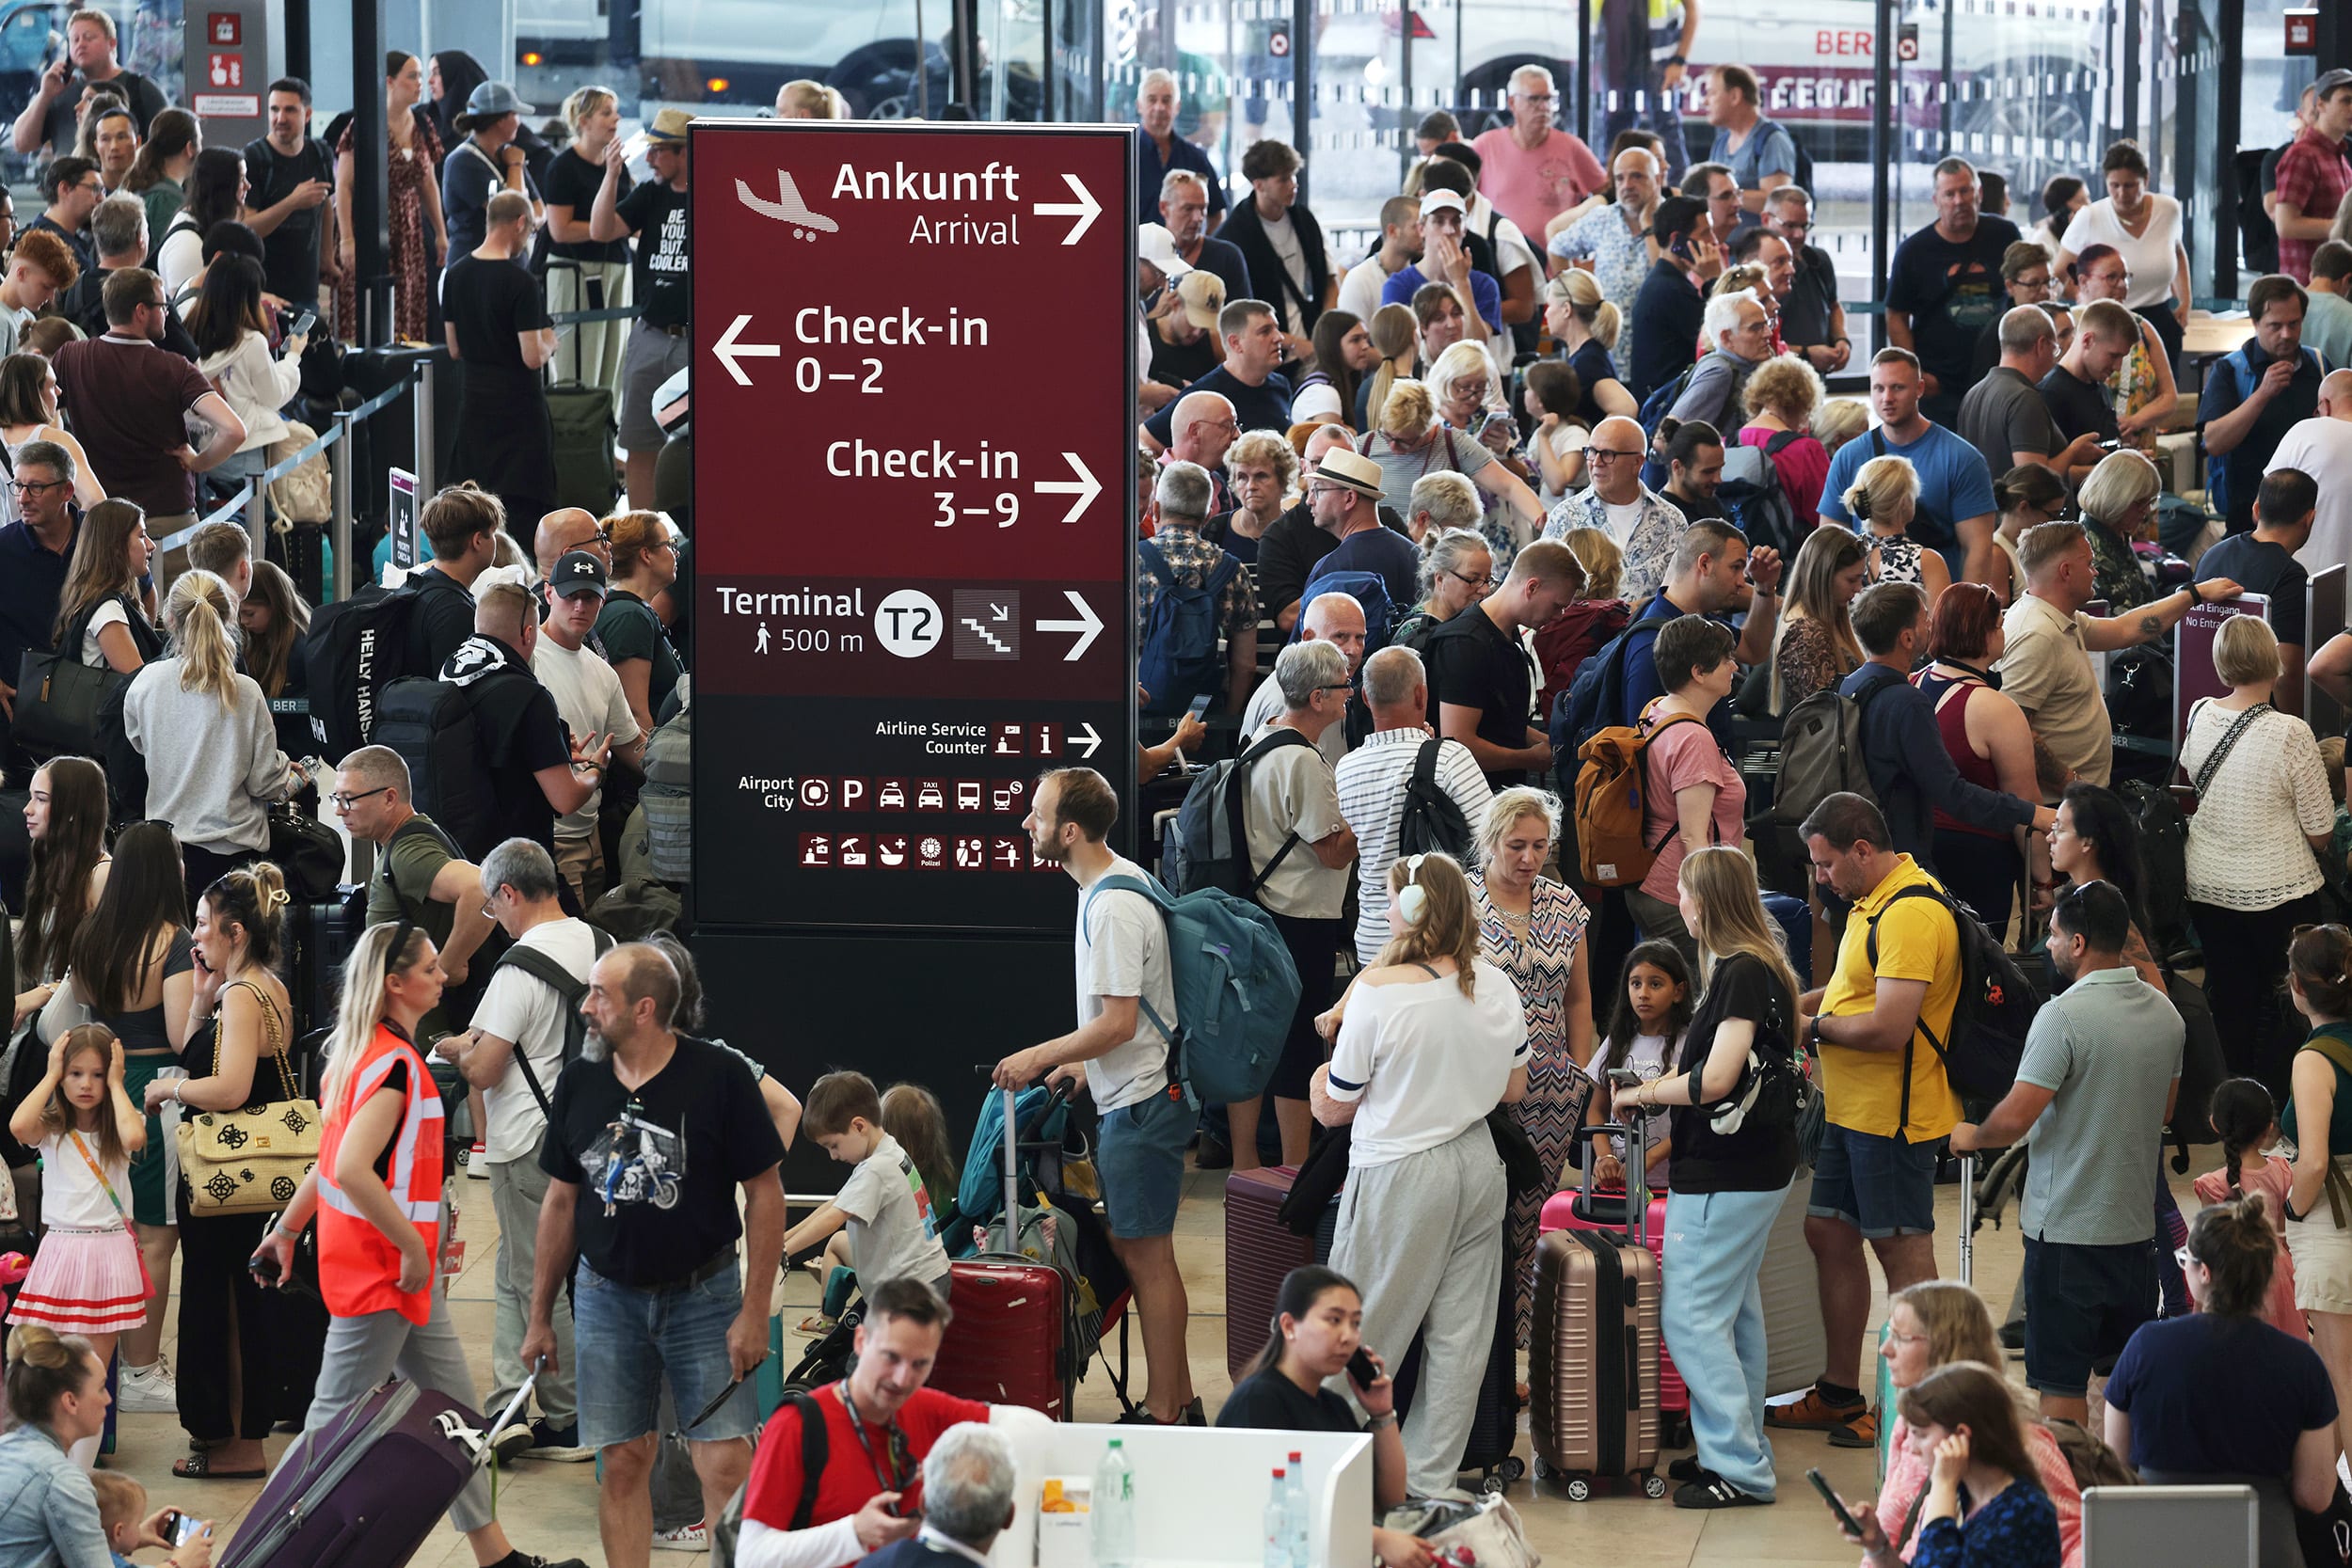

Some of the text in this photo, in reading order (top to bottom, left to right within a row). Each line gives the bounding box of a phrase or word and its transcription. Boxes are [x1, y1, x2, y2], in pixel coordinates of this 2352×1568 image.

[1816, 30, 1872, 55] BER
[832, 161, 1020, 202] Ankunft
[909, 213, 1020, 245] Arrival
[795, 305, 988, 346] Check-in
[826, 438, 1019, 480] Check-in
[716, 586, 865, 617] Terminal
[884, 608, 931, 641] T2
[2185, 616, 2221, 628] No Entra
[782, 628, 863, 653] 500 m
[358, 628, 374, 680] HELLY
[273, 700, 296, 711] BER
[875, 721, 987, 736] Airline Service
[925, 740, 987, 754] Counter
[2111, 735, 2128, 748] BER
[739, 776, 794, 793] Airport
[764, 794, 794, 812] City
[920, 859, 941, 867] Polizei
